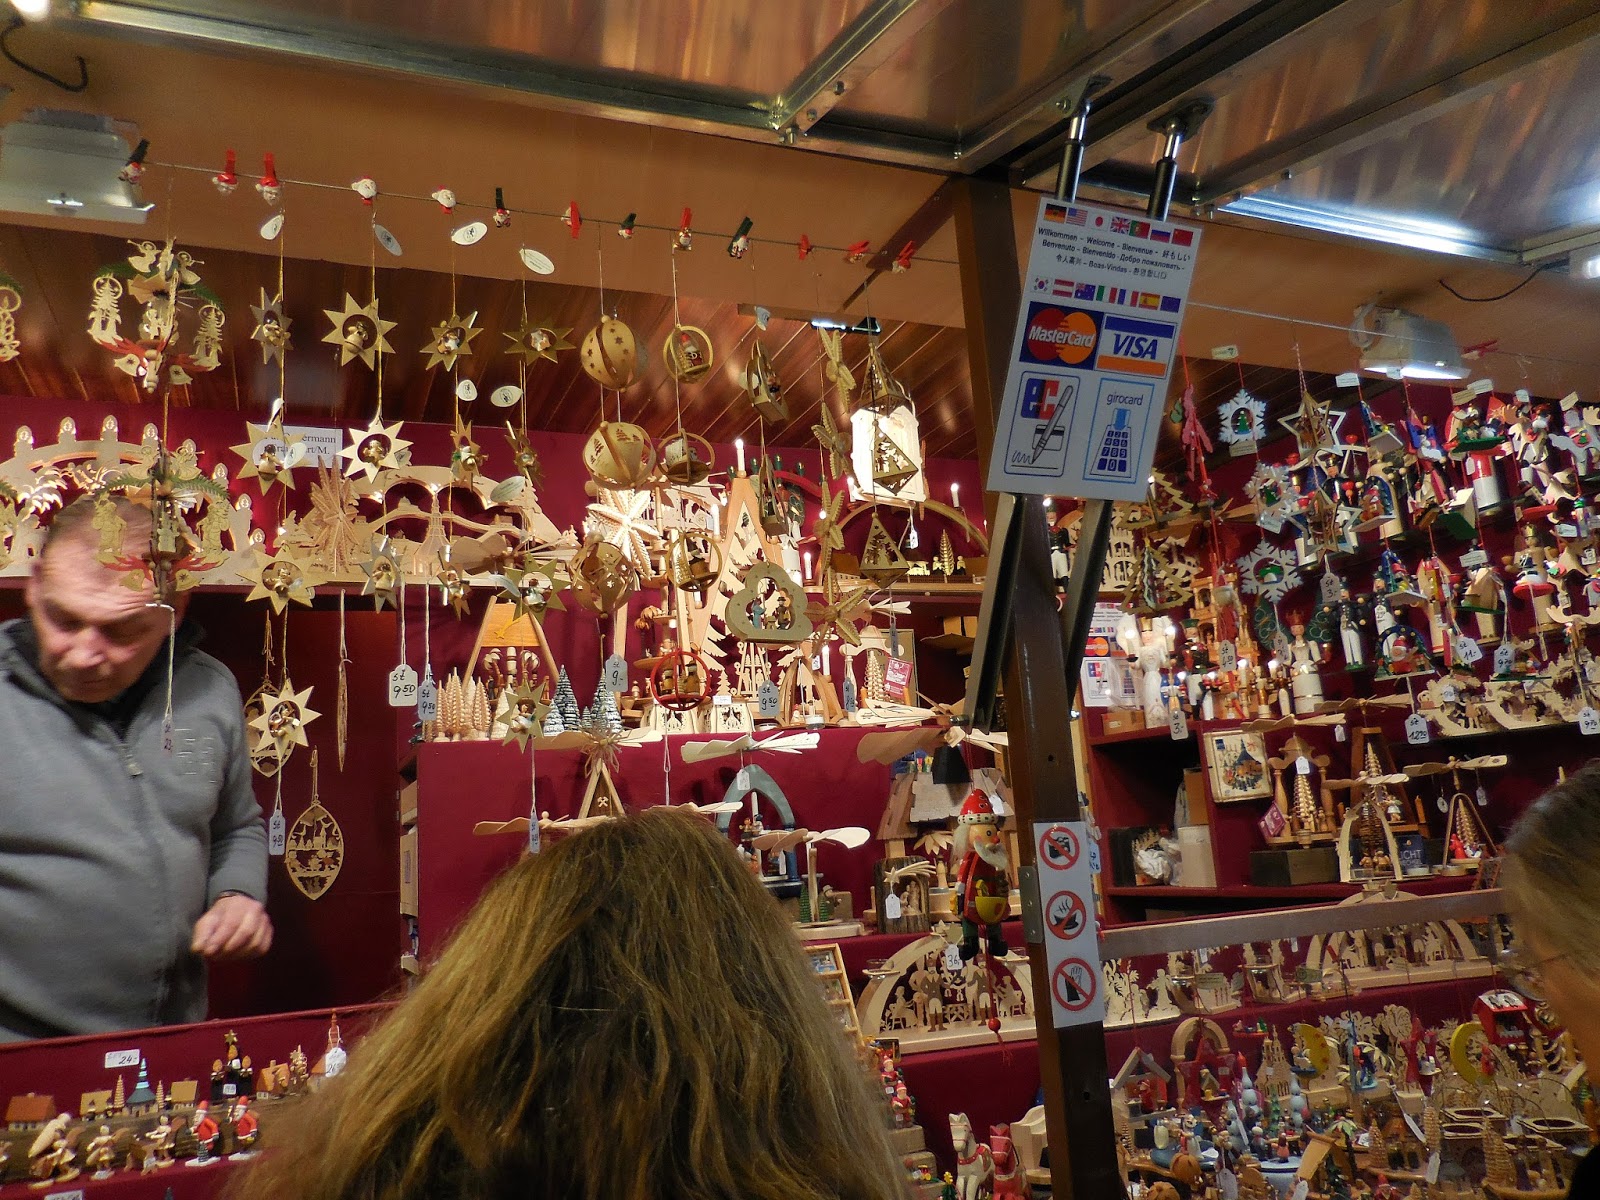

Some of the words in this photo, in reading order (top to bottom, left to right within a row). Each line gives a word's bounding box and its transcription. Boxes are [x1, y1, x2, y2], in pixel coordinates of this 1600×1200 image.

[1038, 227, 1077, 241] Willkommen
[1086, 237, 1115, 248] Welcome
[1122, 243, 1153, 255] Bienvenue
[1042, 239, 1075, 251] Benvenuto
[1082, 247, 1116, 259] Bienvenido
[1089, 260, 1127, 273] Boas-Vindas
[1119, 254, 1140, 264] Добро
[1029, 325, 1095, 348] MasterCard
[1113, 333, 1158, 360] VISA
[1106, 391, 1144, 406] girocard
